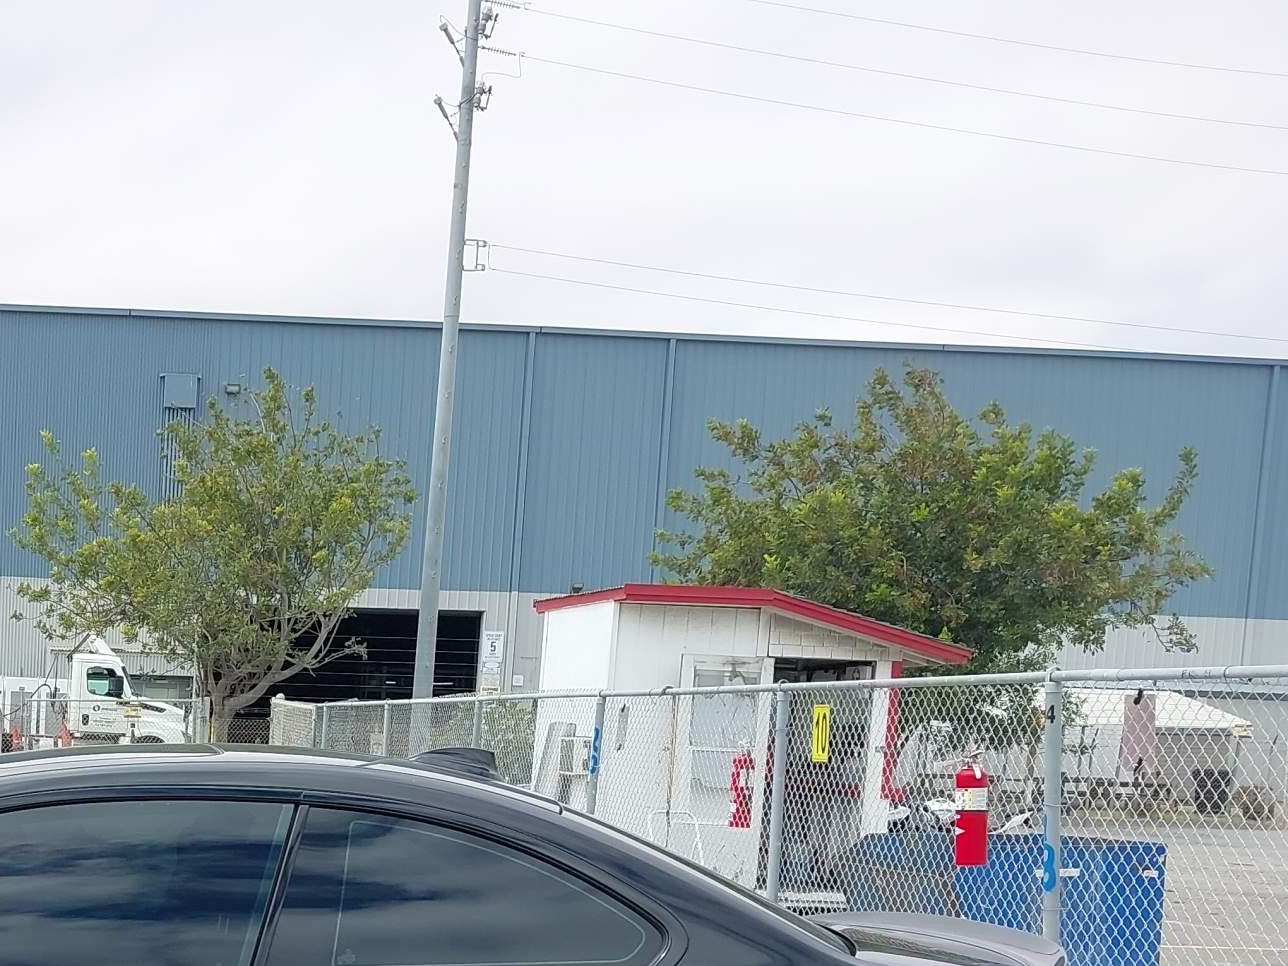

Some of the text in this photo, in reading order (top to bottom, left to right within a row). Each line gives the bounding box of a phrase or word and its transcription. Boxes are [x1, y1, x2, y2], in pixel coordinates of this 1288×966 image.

[490, 641, 497, 652] 5
[1047, 704, 1056, 724] 4
[815, 711, 828, 754] 10
